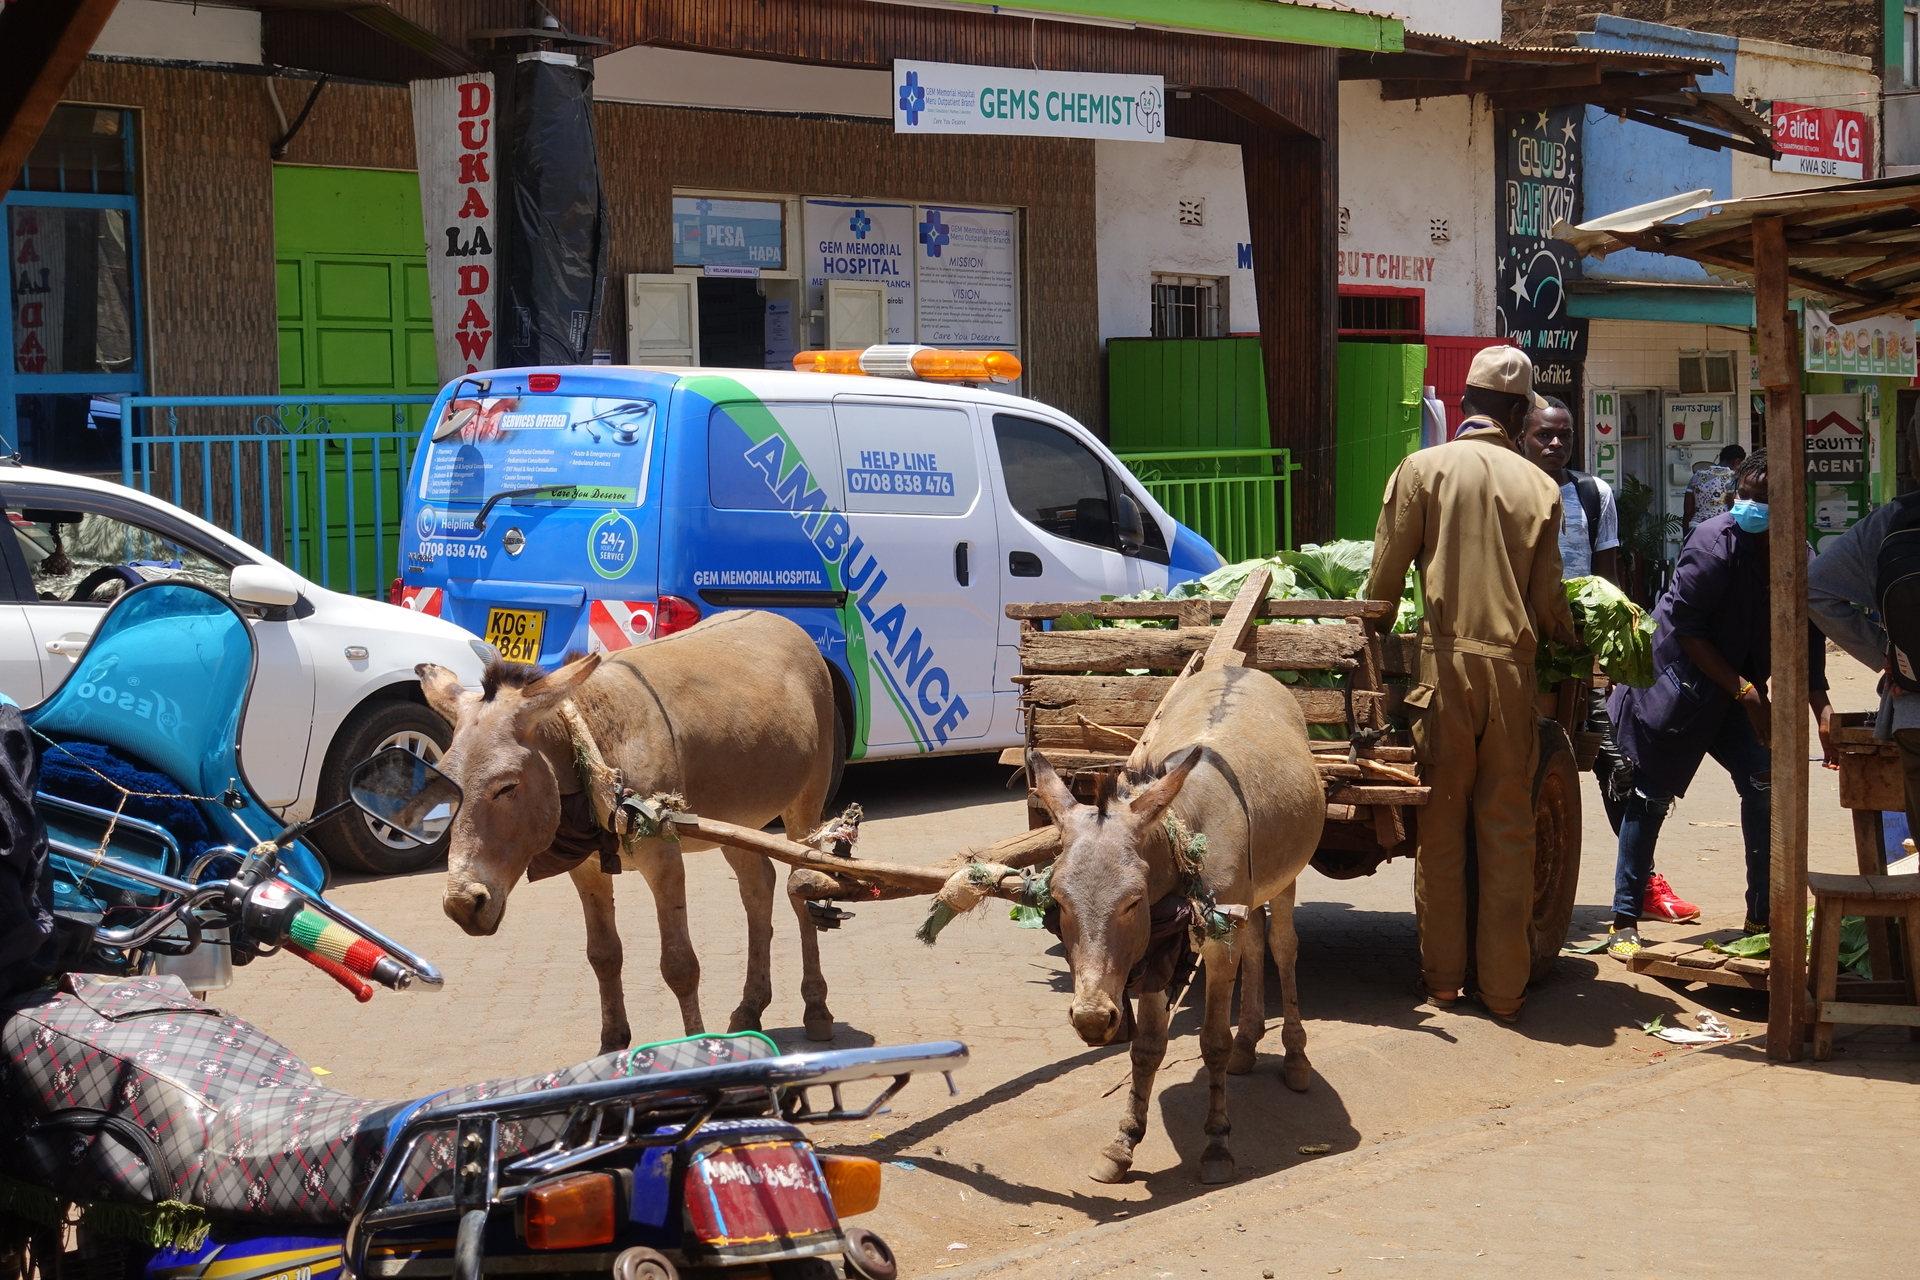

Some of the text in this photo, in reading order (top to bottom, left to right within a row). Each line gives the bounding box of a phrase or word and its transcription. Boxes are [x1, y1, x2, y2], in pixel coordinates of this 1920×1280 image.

[926, 88, 936, 96] GEM
[980, 87, 1135, 126] GEMS CHEMIST
[1143, 98, 1151, 106] 24
[1790, 114, 1860, 158] airtel 4G
[1518, 136, 1566, 180] CLUB
[1800, 158, 1837, 175] KWA SUE
[445, 82, 493, 374] DUKA LA DAW
[706, 224, 746, 247] PESA
[951, 224, 1010, 238] GEM Memorial Hospital
[749, 246, 781, 262] HAPA
[820, 241, 902, 256] GEM MEMORIAL
[824, 257, 900, 276] HOSPITAL
[949, 256, 984, 268] MISSION
[1338, 252, 1436, 282] BUTCHERY
[881, 280, 911, 288] RANCH
[952, 288, 980, 300] VISION
[933, 331, 1001, 342] Care You Deserve
[1538, 330, 1578, 350] MATHY
[1534, 364, 1572, 384] Rafikiz
[1672, 404, 1722, 413] FRUITS JUICES
[502, 414, 567, 428] SERVICES OFFERED
[1806, 437, 1864, 450] EQUITY
[590, 450, 611, 458] Emergency
[860, 450, 938, 472] HELP LINE
[1807, 459, 1863, 473] AGENT
[852, 472, 951, 494] 0708 838 476
[551, 488, 626, 500] Care You Deserve
[441, 518, 474, 532] Helpline
[601, 532, 626, 552] 24/7
[419, 542, 444, 557] 0708
[446, 543, 466, 558] 838
[468, 544, 488, 560] 476
[600, 552, 624, 562] SERVICE
[694, 570, 822, 586] GEM MEMORIAL HOSPITAL
[744, 432, 970, 746] AMBULANCE
[491, 612, 526, 636] KDG
